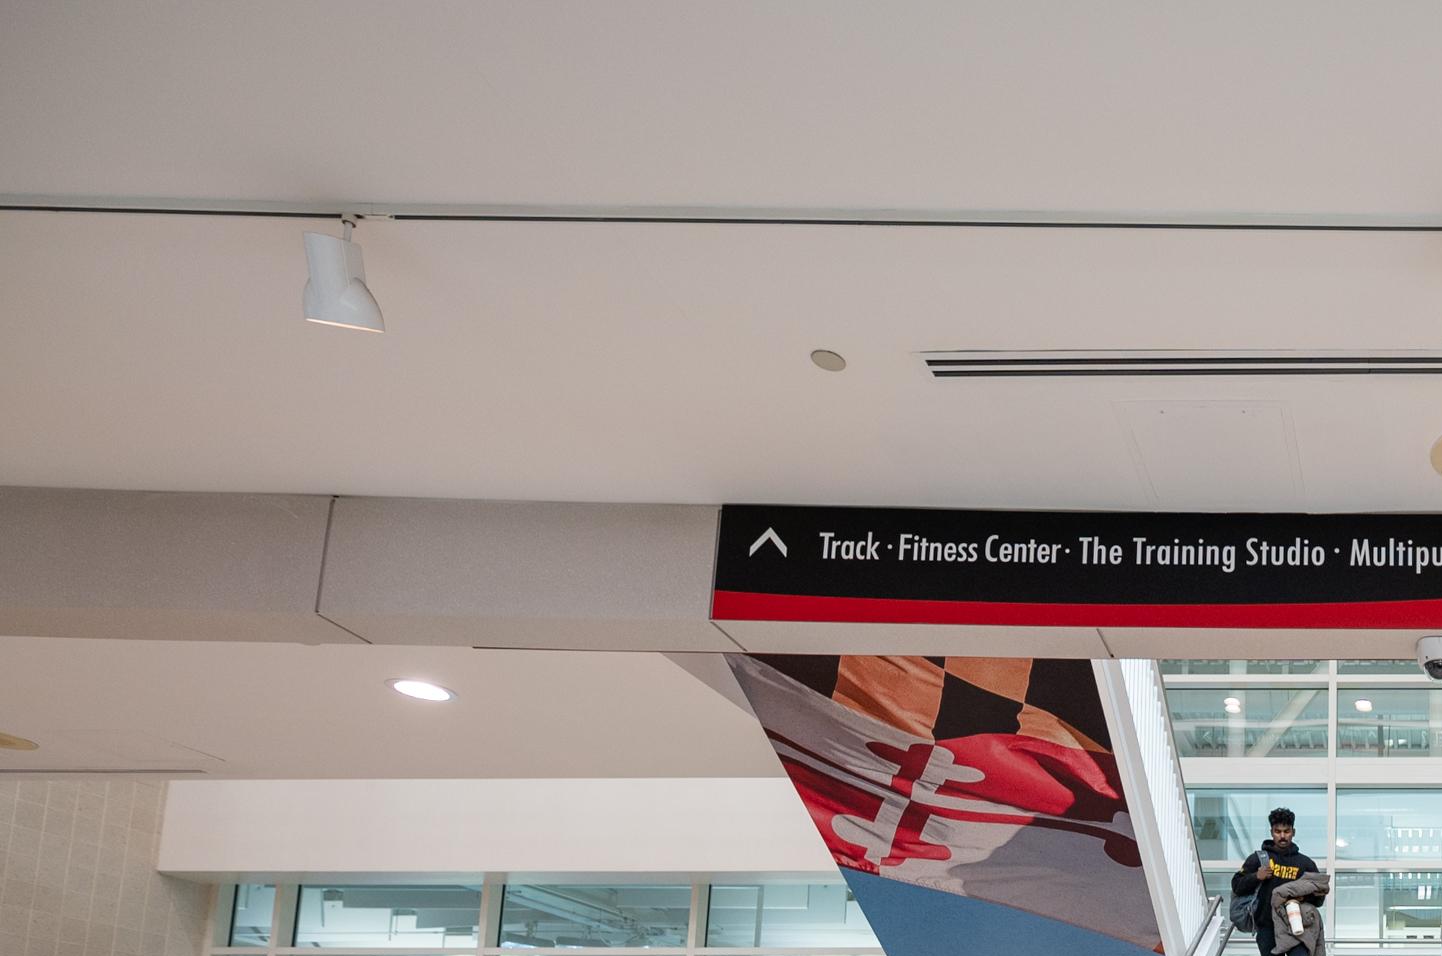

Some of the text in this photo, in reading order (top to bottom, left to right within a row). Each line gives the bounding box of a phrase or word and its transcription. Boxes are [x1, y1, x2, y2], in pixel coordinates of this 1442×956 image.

[819, 531, 880, 560] Track
[898, 533, 978, 562] Fitness
[984, 534, 1062, 564] Center
[1078, 536, 1123, 565] The
[1132, 537, 1236, 573] Training
[1245, 537, 1325, 566] Studio
